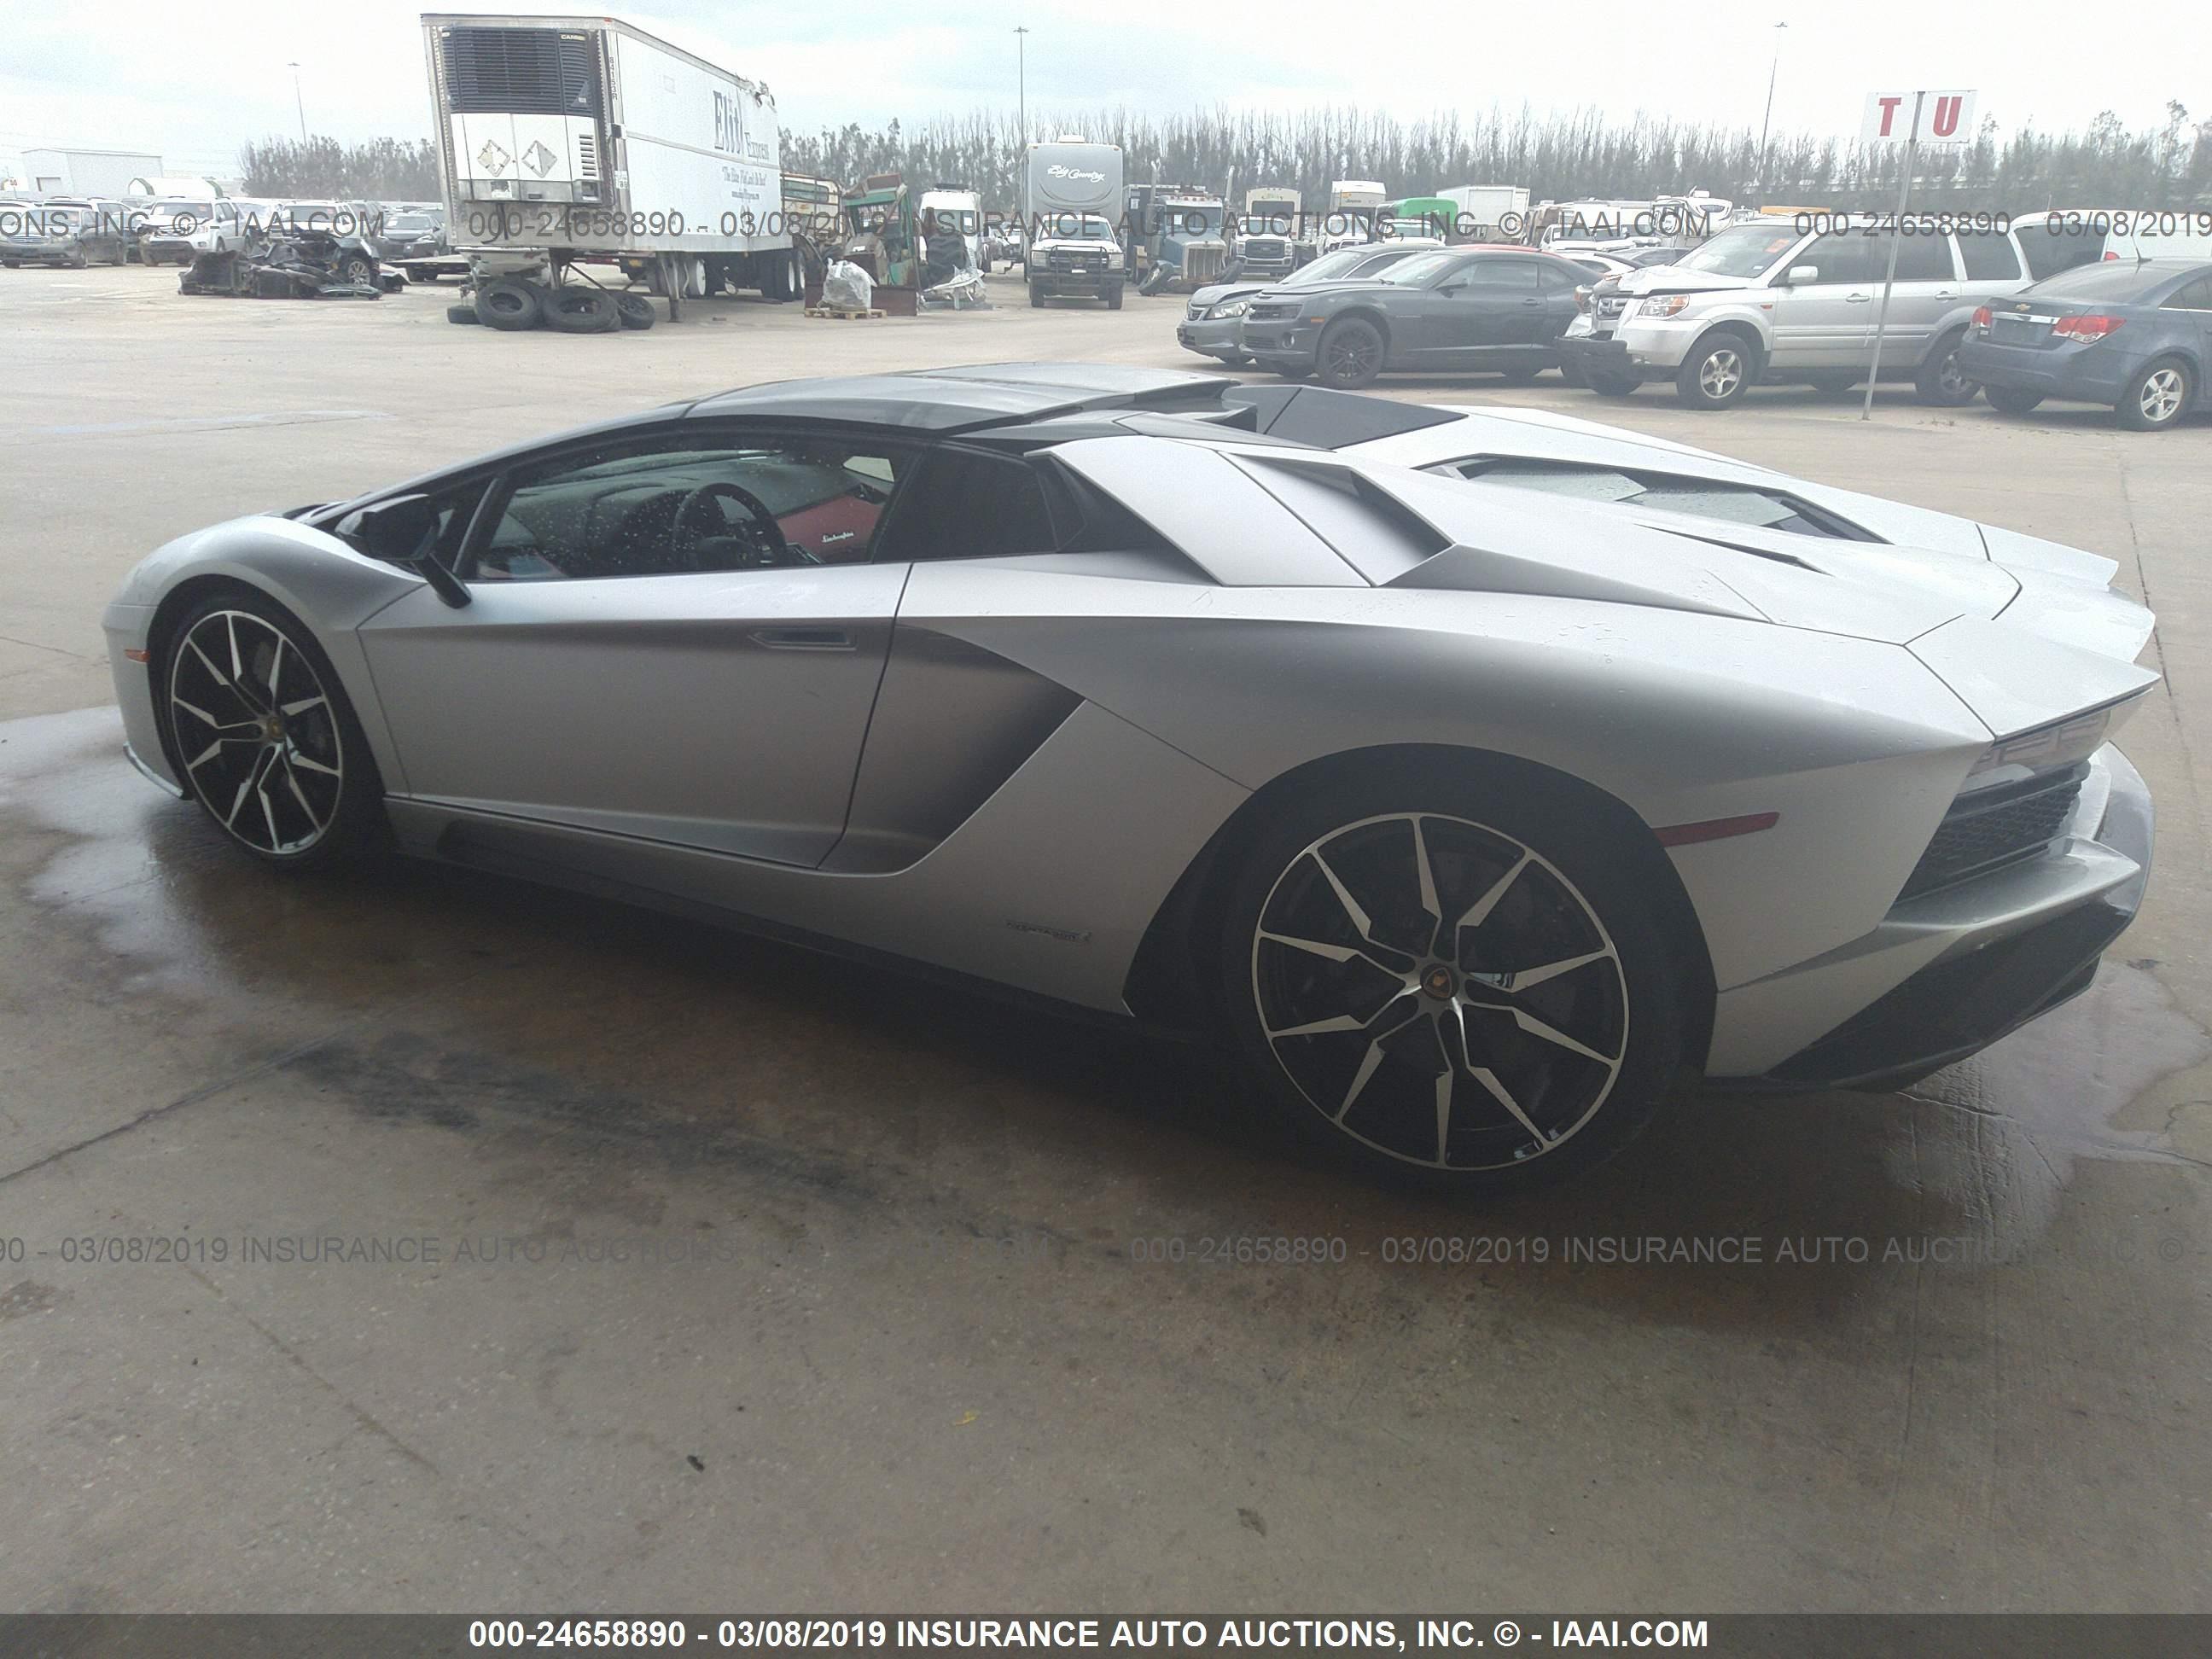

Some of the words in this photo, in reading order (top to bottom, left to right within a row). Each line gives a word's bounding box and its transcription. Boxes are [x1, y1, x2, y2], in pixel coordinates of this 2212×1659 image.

[1878, 97, 1902, 137] T
[1933, 96, 1963, 137] U
[1047, 164, 1069, 178] Big
[1068, 169, 1106, 183] Country
